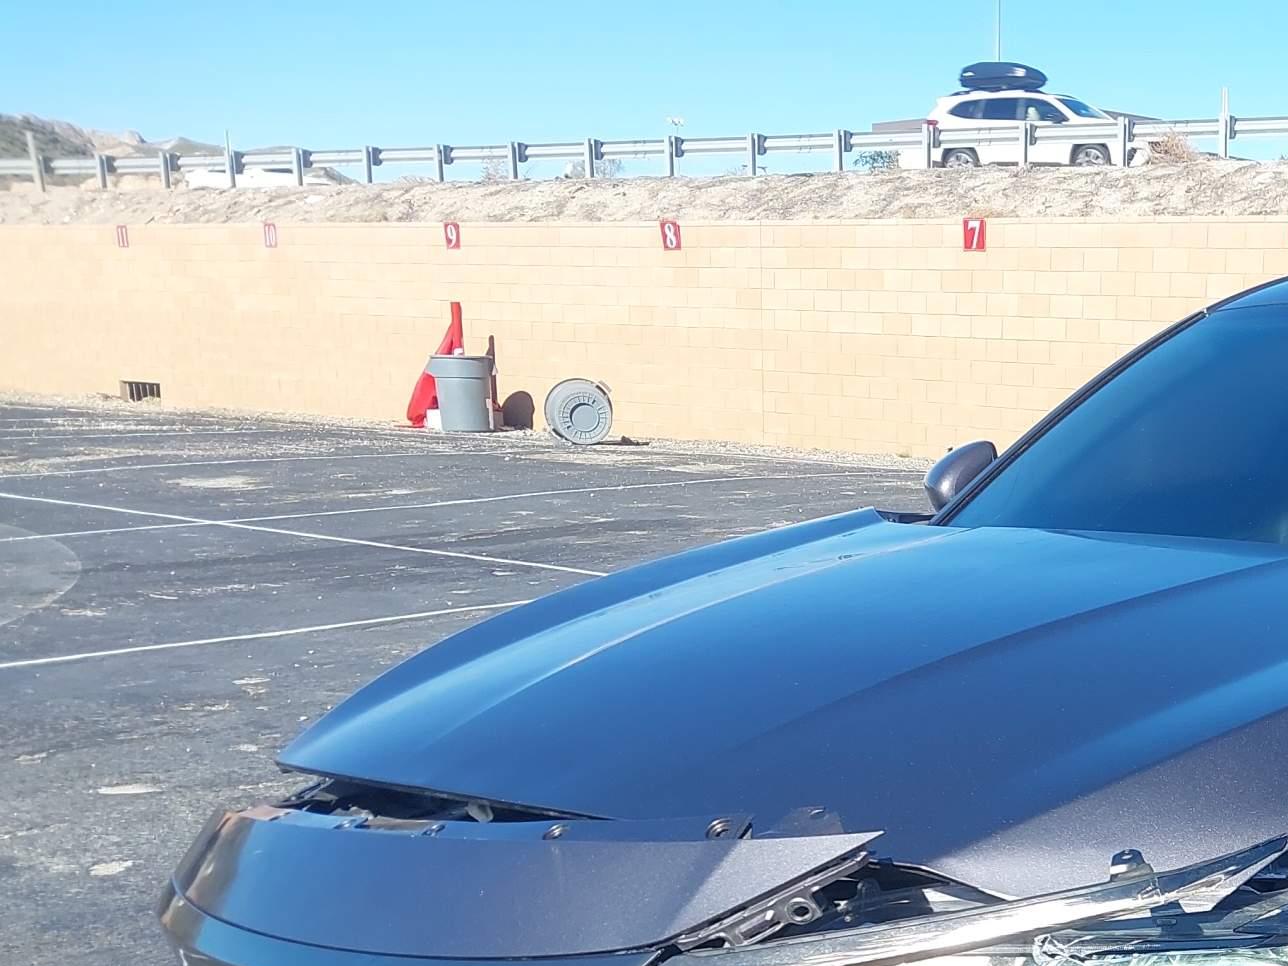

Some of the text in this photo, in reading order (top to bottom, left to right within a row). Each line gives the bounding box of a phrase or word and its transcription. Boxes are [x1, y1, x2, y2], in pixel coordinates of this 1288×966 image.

[447, 224, 457, 248] 9
[664, 223, 676, 248] 8
[967, 220, 981, 249] 7
